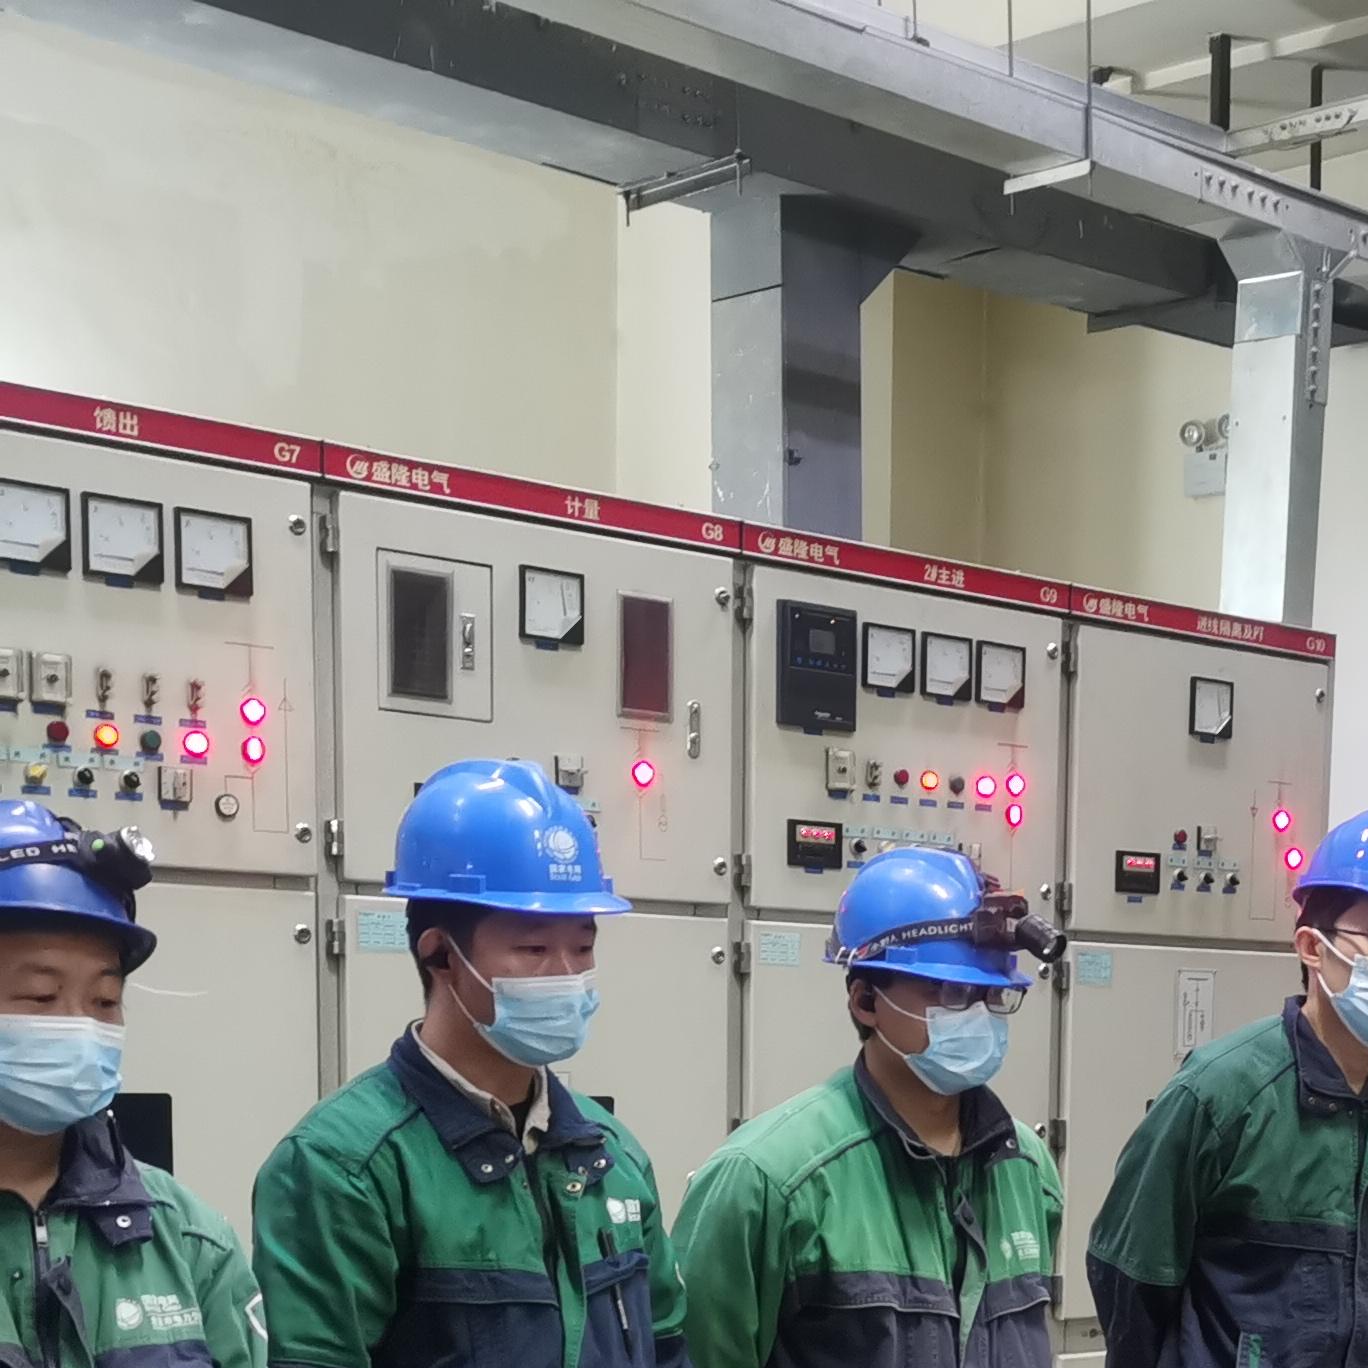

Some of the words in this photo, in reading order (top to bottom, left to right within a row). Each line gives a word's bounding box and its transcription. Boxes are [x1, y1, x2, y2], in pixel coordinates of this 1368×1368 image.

[93, 406, 139, 436] 馈出
[273, 442, 301, 463] G7
[371, 460, 451, 494] 盛隆电气
[564, 495, 601, 521] 计量
[701, 522, 724, 541] G8
[777, 538, 840, 565] 盛隆电气
[1039, 587, 1058, 604] G9
[1099, 598, 1150, 623] 盛隆电气
[1306, 636, 1326, 653] G10
[901, 921, 975, 940] HEADLIGHT
